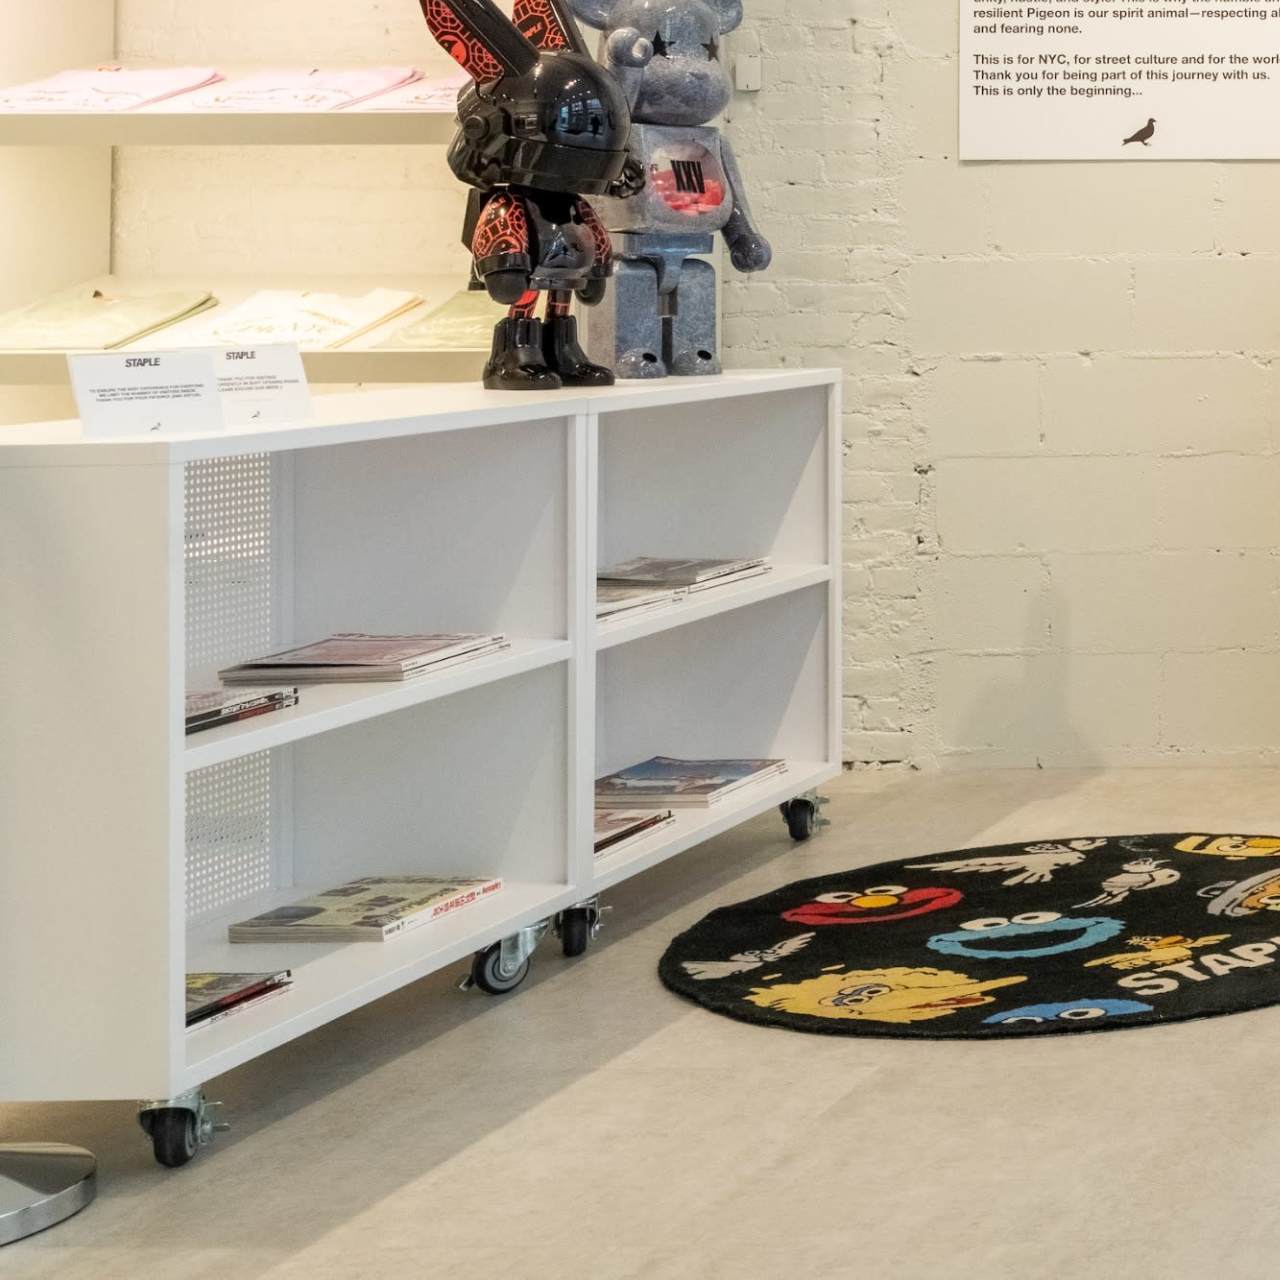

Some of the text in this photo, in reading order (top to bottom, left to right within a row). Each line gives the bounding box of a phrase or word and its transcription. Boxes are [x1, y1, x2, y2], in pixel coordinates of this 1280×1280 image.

[670, 160, 705, 193] XXV
[226, 351, 256, 360] STAPLE
[125, 357, 161, 368] STAPLE
